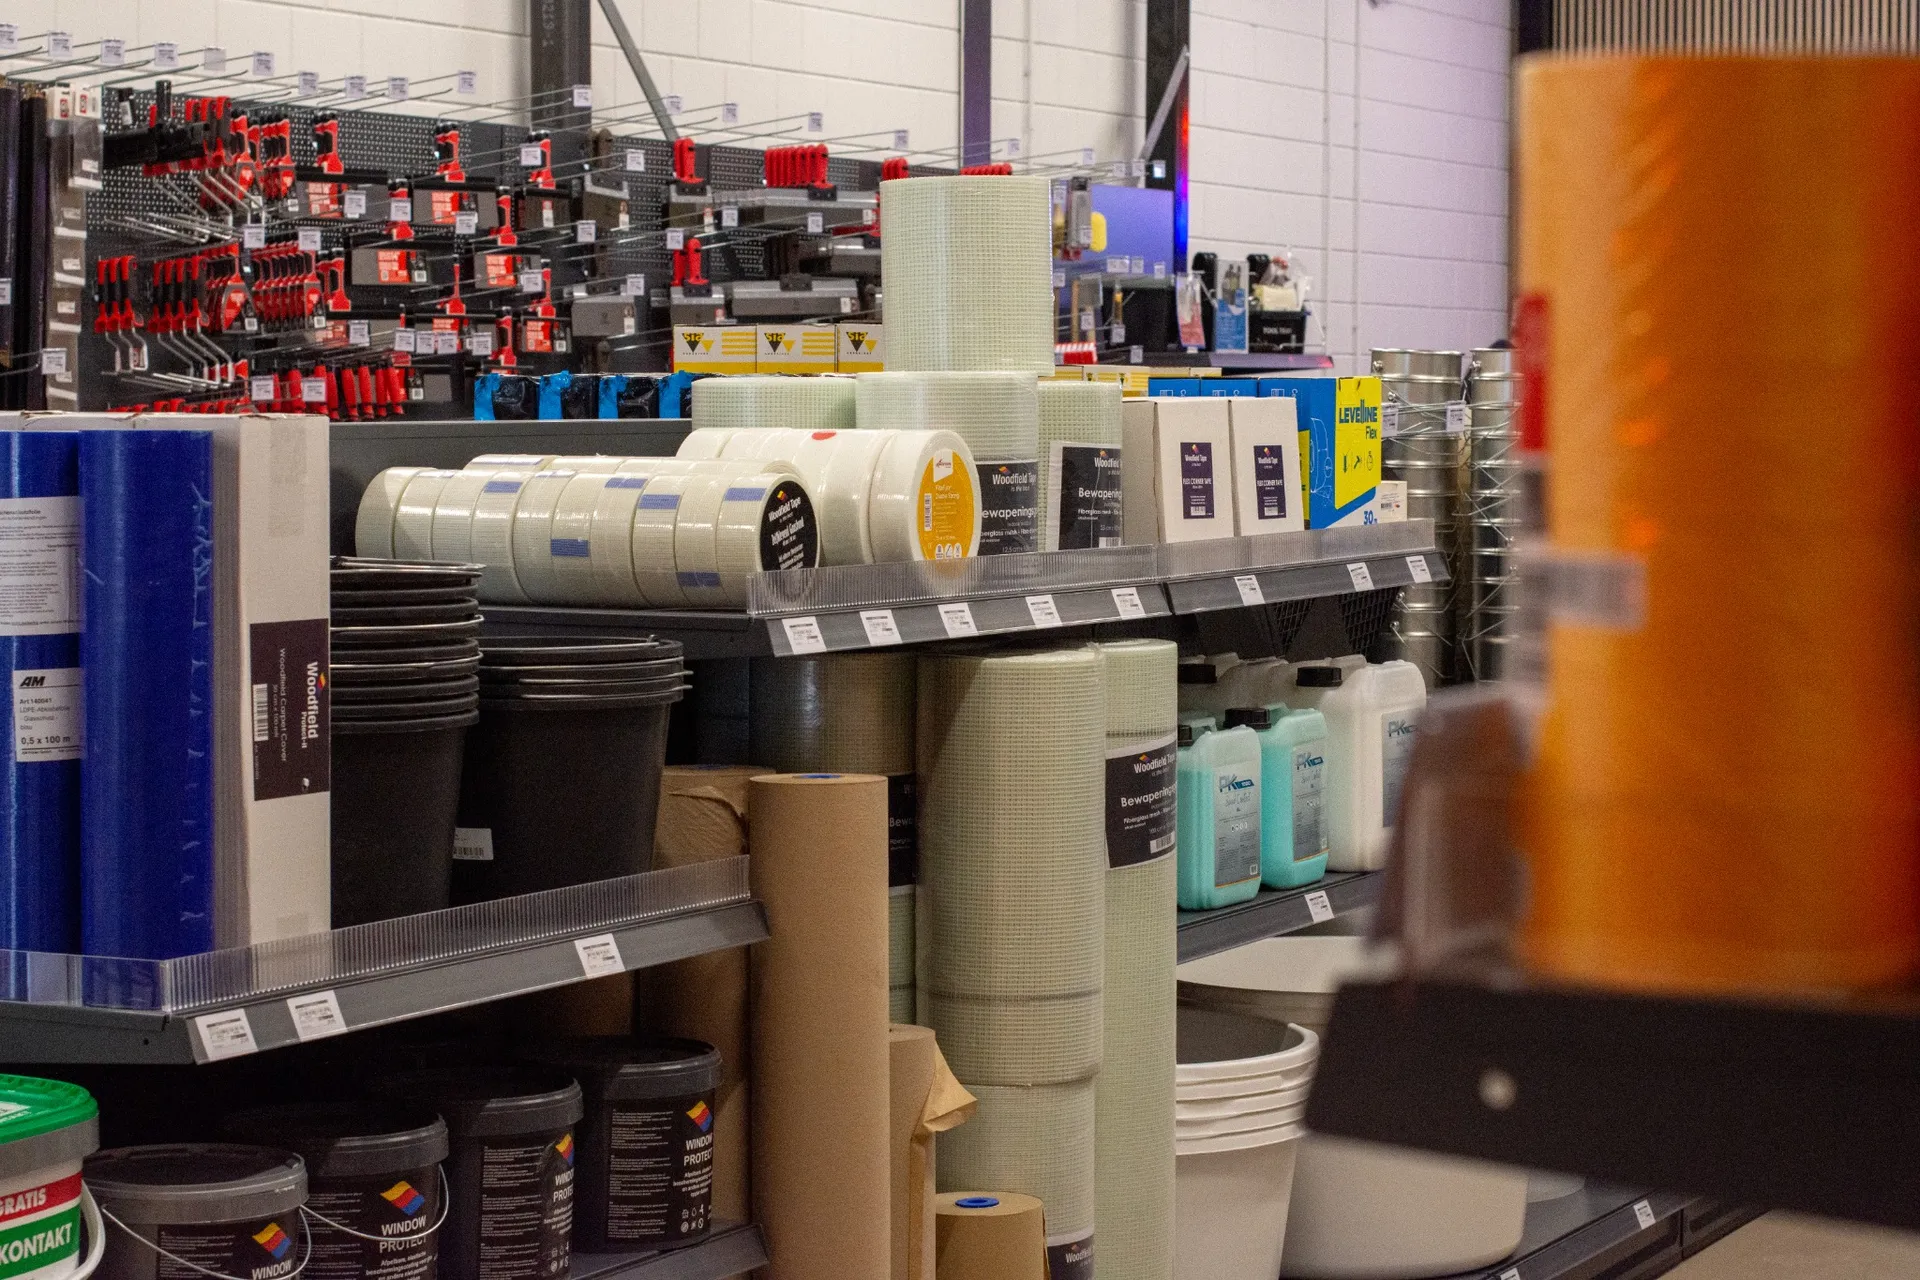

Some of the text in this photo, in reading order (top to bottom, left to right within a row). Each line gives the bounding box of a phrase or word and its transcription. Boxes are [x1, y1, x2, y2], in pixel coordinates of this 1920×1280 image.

[1365, 426, 1377, 439] Flex
[992, 472, 1027, 485] Woodfield
[20, 676, 46, 687] AM
[306, 662, 318, 739] Woodfield
[21, 736, 35, 746] 0,5
[45, 735, 61, 744] 100
[1133, 757, 1166, 774] Woodfield
[381, 1214, 427, 1236] WINDOW
[379, 1237, 427, 1254] PROTECT
[252, 1259, 292, 1280] WINDOW
